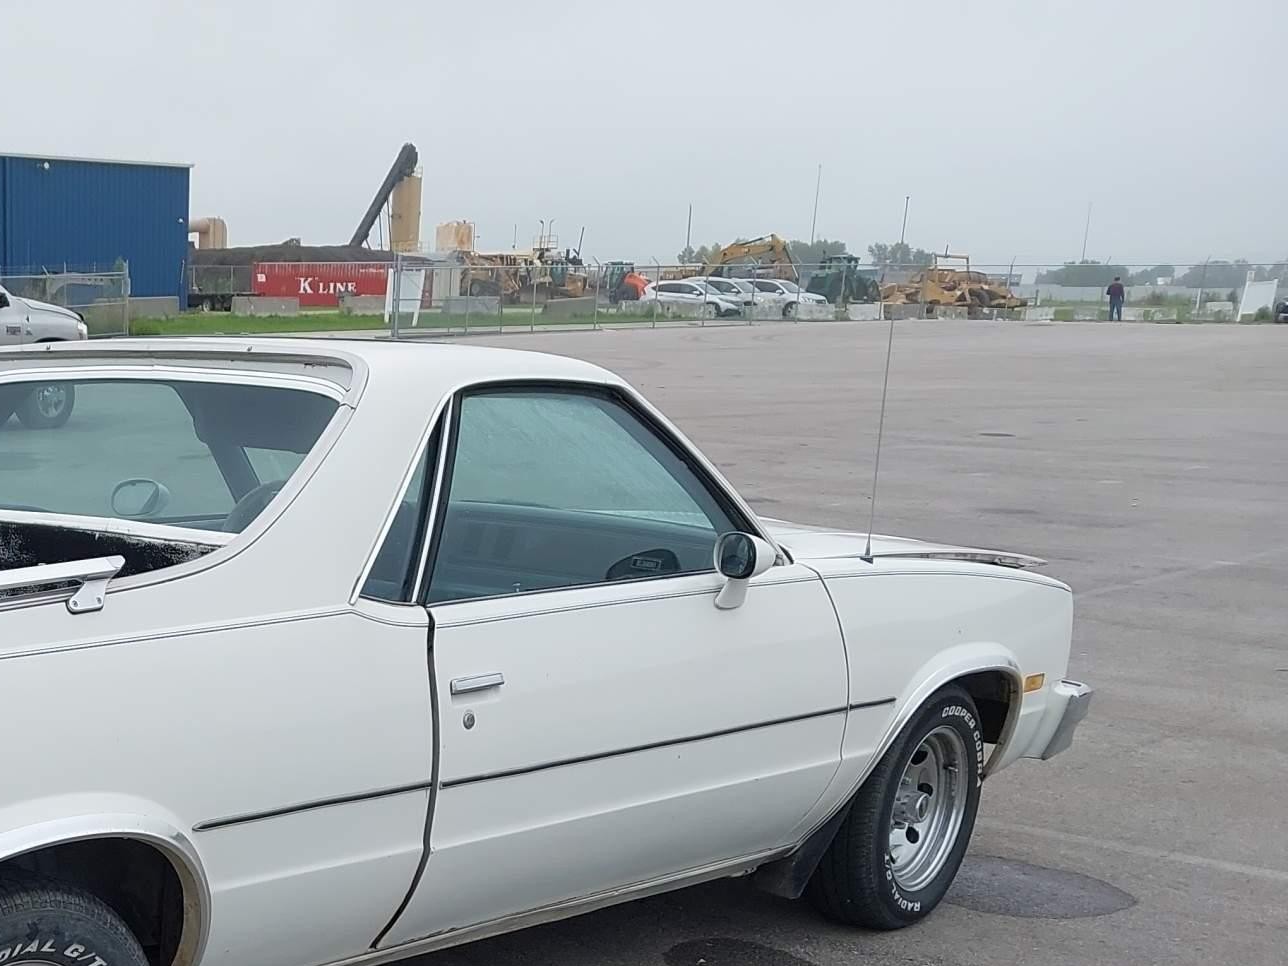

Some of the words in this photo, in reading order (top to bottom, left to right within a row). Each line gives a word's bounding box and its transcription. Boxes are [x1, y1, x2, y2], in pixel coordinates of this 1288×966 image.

[941, 705, 976, 729] COOPER
[973, 730, 983, 788] COBRA
[892, 882, 921, 912] RADIAL
